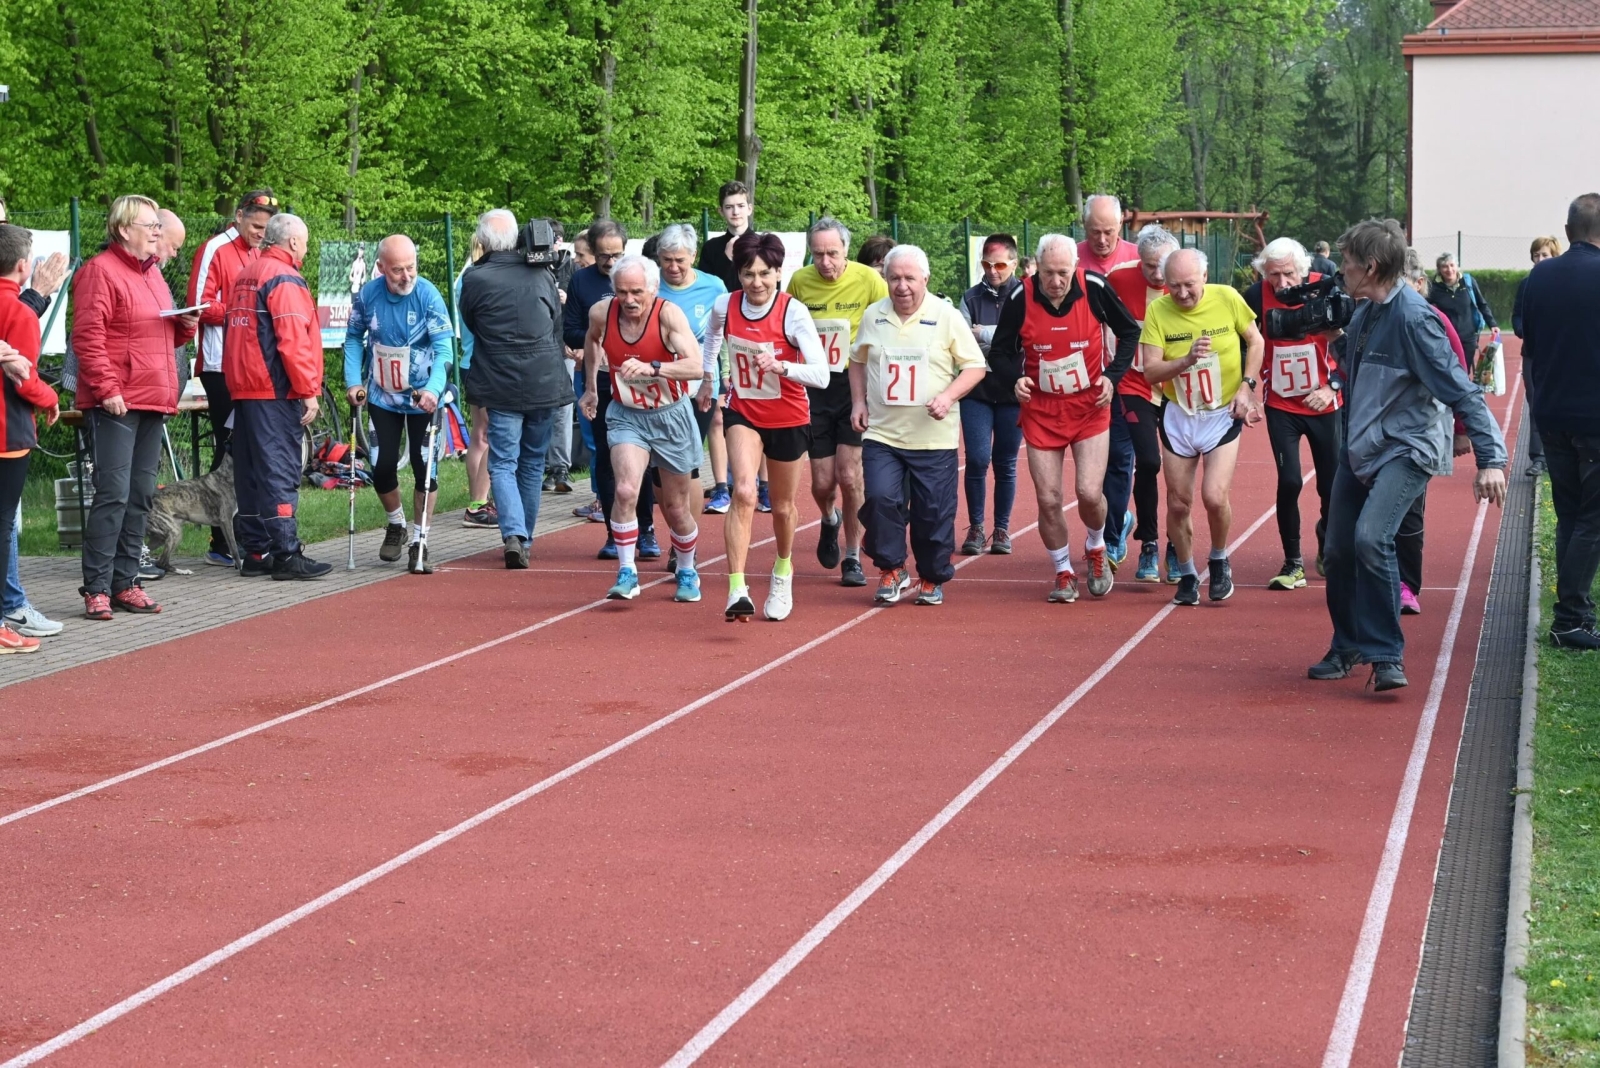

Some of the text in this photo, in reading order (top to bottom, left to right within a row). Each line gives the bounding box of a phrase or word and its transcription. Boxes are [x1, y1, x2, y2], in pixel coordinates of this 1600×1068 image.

[731, 343, 748, 352] PIVOVAR
[378, 357, 402, 390] 10
[736, 353, 765, 390] 87
[887, 363, 916, 401] 21
[1194, 361, 1213, 370] TRUTNOV
[1280, 357, 1312, 392] 53
[1180, 369, 1214, 409] 70
